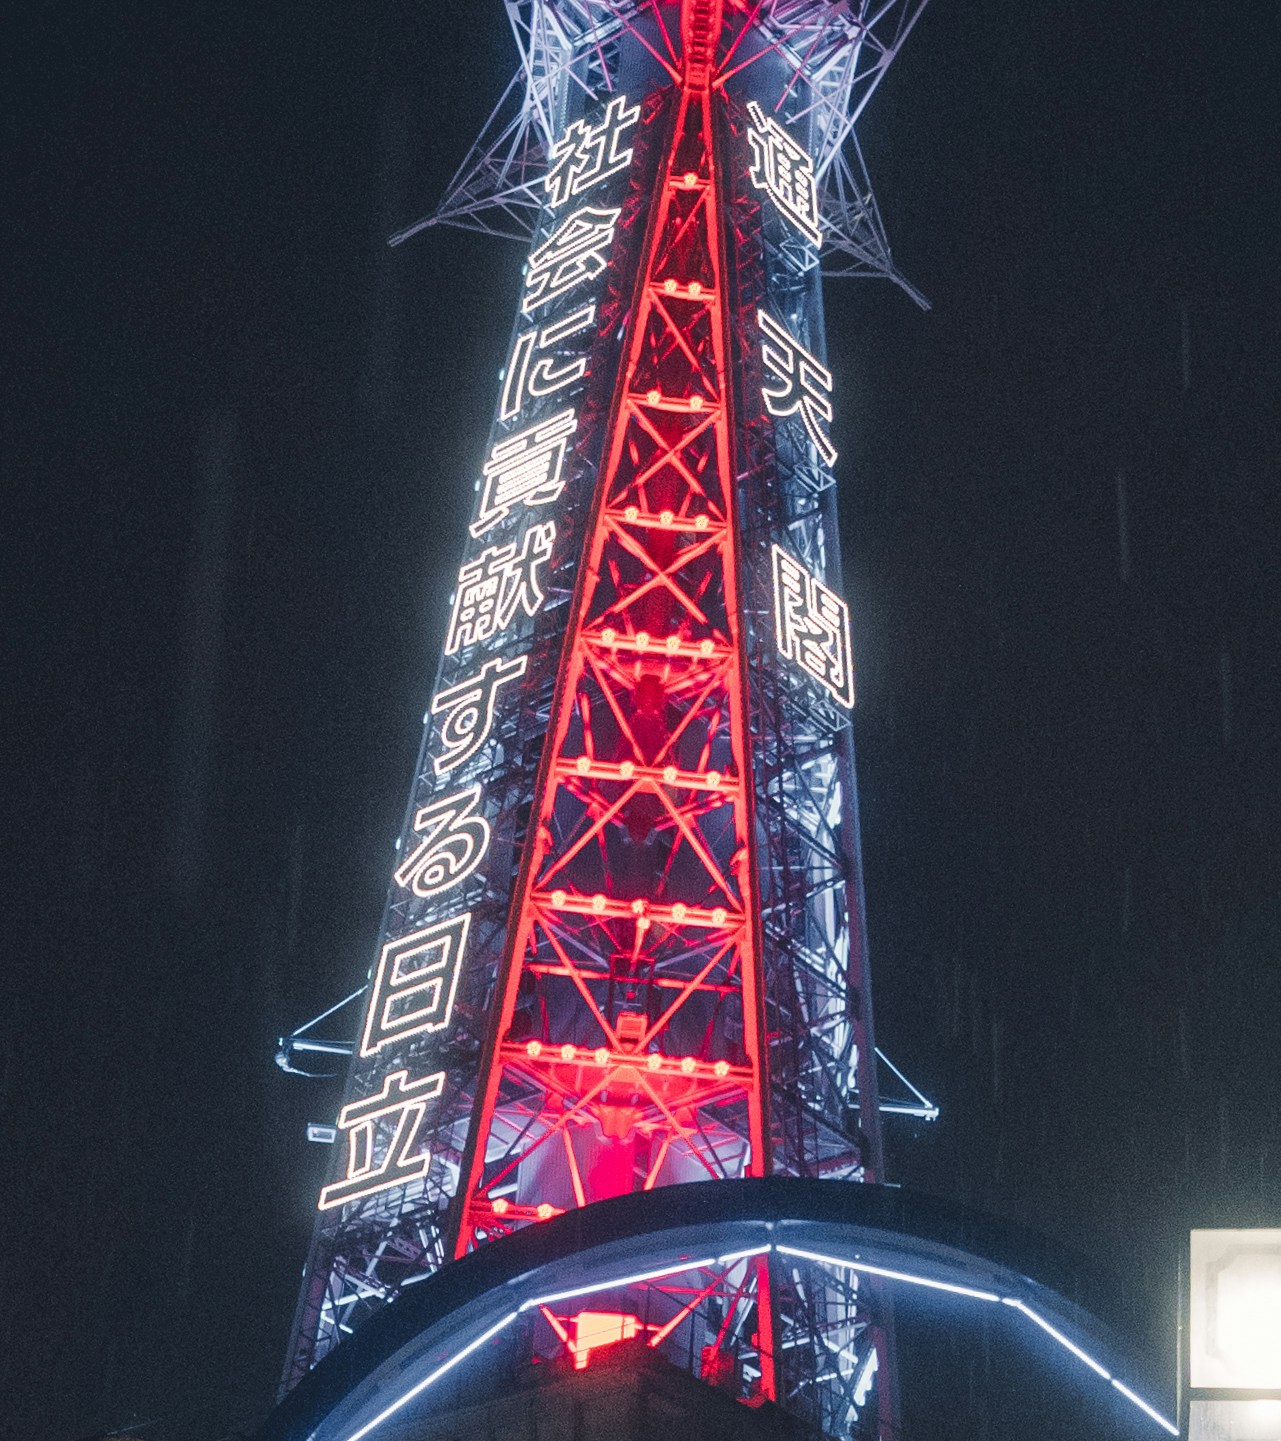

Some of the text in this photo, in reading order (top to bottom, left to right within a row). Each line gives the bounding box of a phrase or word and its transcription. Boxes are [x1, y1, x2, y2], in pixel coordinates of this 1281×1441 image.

[318, 95, 641, 1210] 社会に貢献する日立
[747, 101, 856, 710] 通天閣
